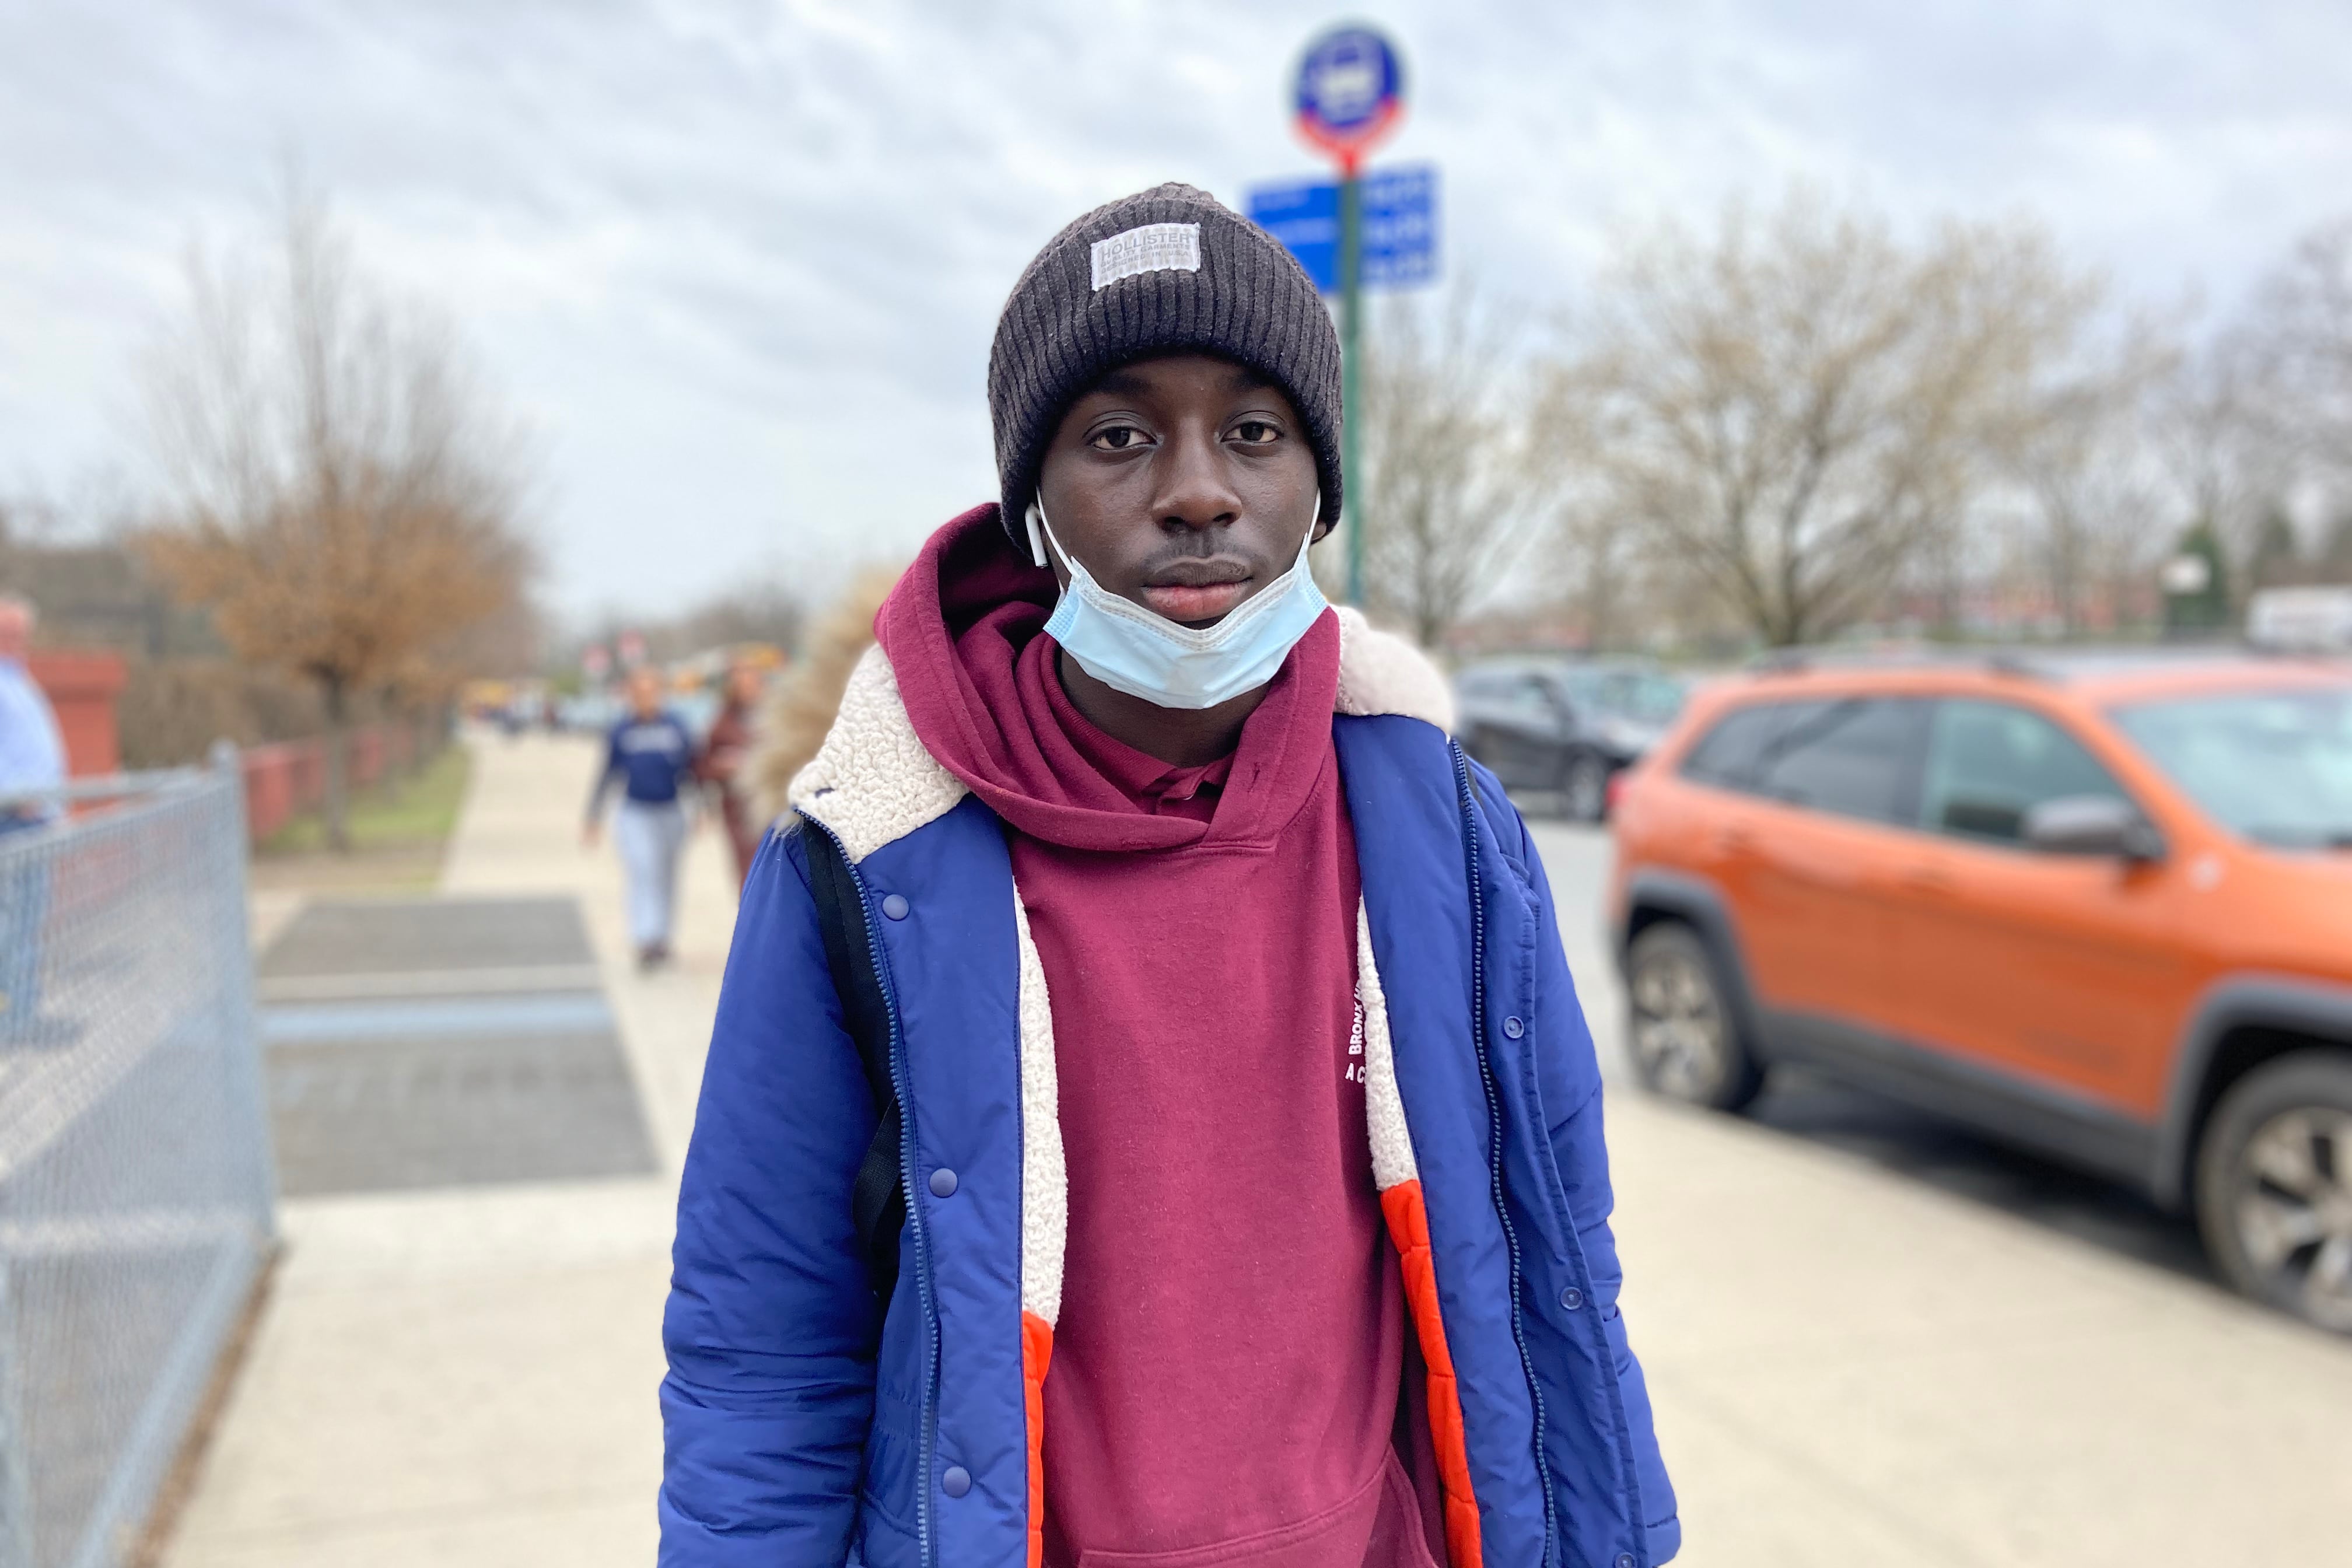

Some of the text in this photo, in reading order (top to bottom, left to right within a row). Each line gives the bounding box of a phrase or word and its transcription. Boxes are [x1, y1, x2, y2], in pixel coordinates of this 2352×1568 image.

[1101, 244, 1189, 267] QUALITY GARMENTS
[1102, 233, 1189, 261] HOLLISTER
[1101, 254, 1146, 274] DESIGNED
[1348, 1001, 1363, 1054] BRONX
